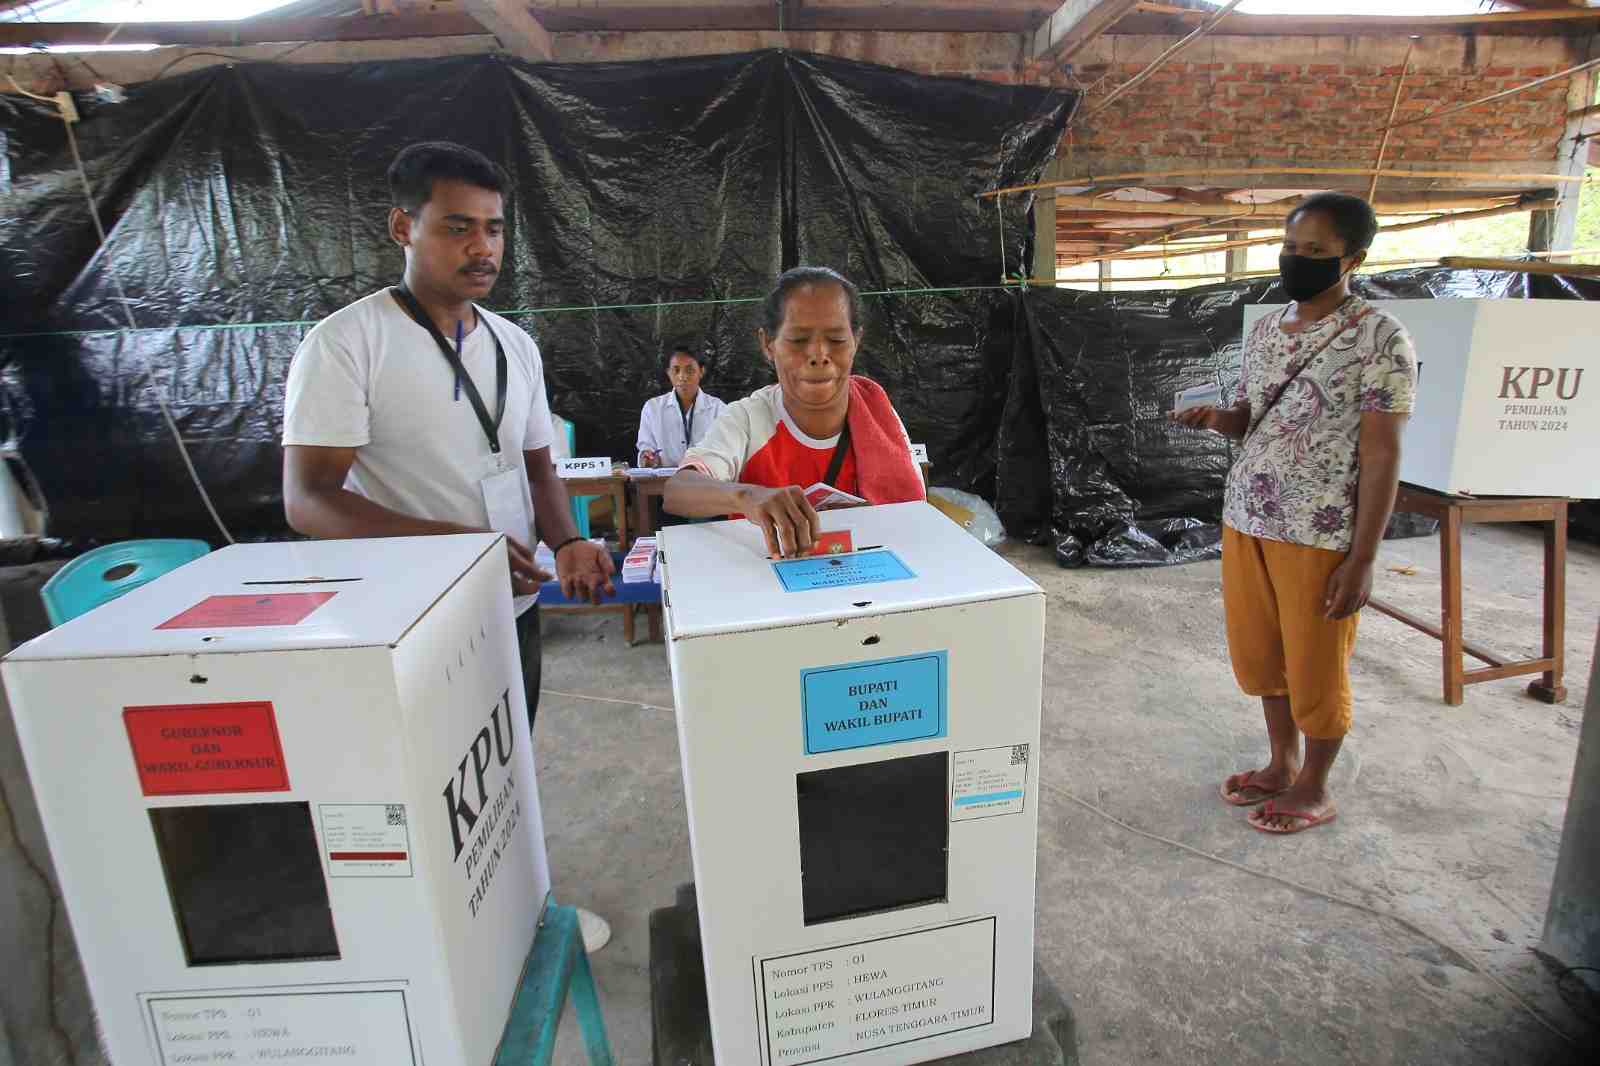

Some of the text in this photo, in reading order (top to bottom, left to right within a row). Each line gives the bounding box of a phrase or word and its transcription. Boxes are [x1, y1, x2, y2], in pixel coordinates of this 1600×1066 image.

[1497, 366, 1584, 400] KPU
[1499, 420, 1568, 431] TAHUN 2024
[1504, 404, 1568, 416] PEMILIHAN
[565, 461, 596, 469] KPPS
[848, 679, 898, 697] BUPATI
[824, 708, 924, 732] WAKIL BUPATI
[858, 698, 888, 712] DAN
[442, 688, 514, 863] KPU
[464, 771, 515, 881] PEMILIHAN
[468, 847, 501, 918] TAHUN
[771, 966, 809, 980] Nomor
[811, 960, 834, 972] TPS
[773, 968, 889, 1000] Lokasi PPS HEWA
[775, 977, 945, 1020] Lokasi PPK WULANGGITANG
[776, 998, 938, 1040] Kabupaten FLORES TIMUR
[856, 1026, 887, 1041] NUSA
[889, 1013, 948, 1034] TENGGARA
[950, 1005, 986, 1021] TIMUR
